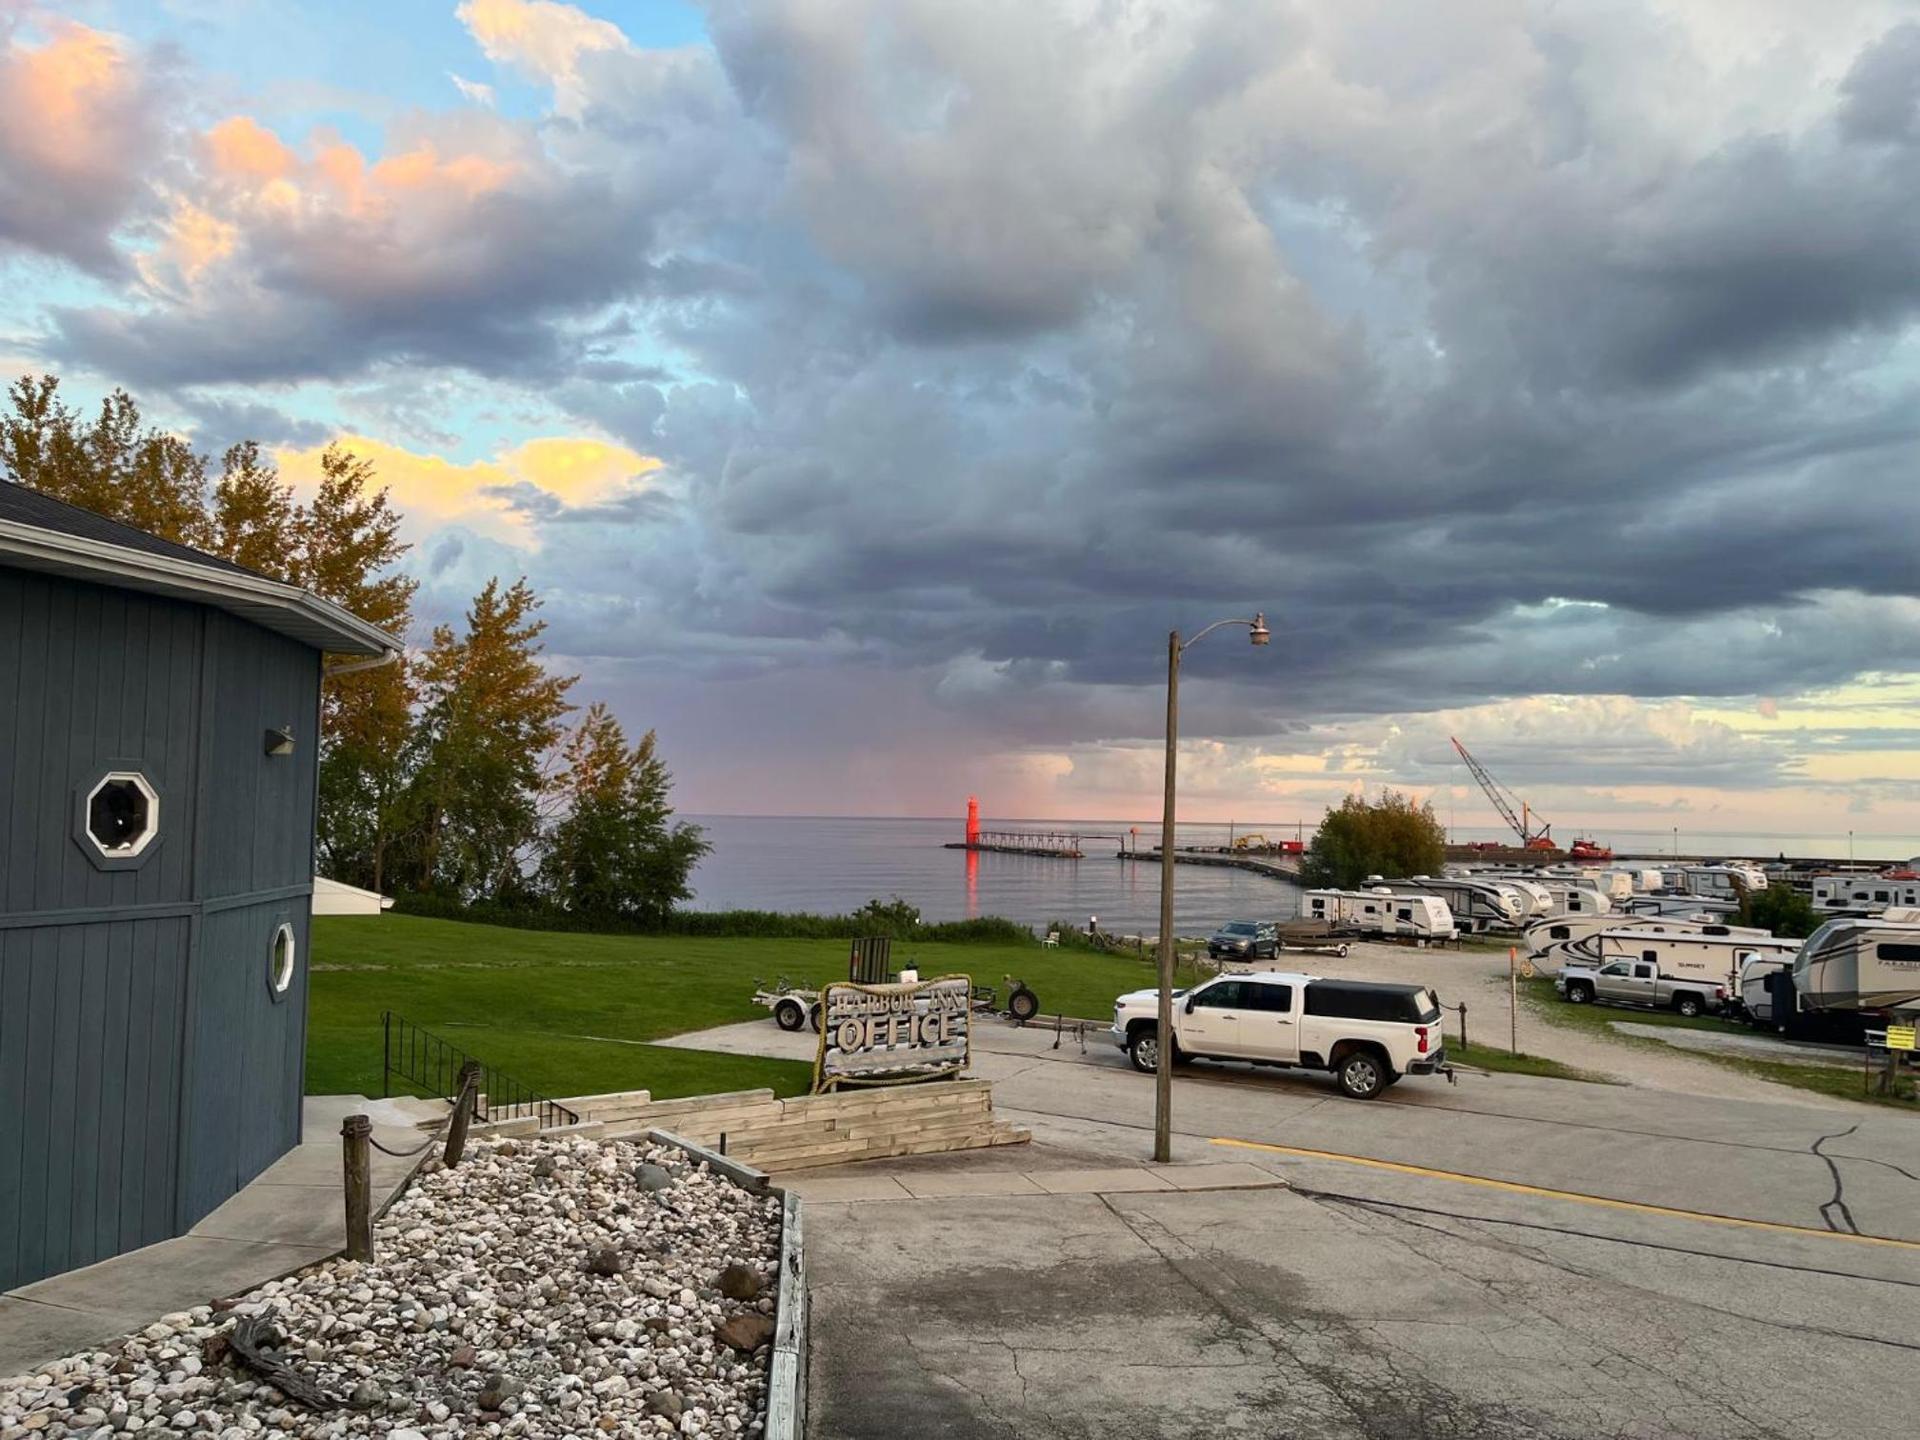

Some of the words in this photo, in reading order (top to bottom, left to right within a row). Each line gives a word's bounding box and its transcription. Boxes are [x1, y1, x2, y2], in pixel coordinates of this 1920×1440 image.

[836, 993, 916, 1015] HARBOR
[928, 988, 961, 1011] INN
[837, 1012, 959, 1053] OFFICE
